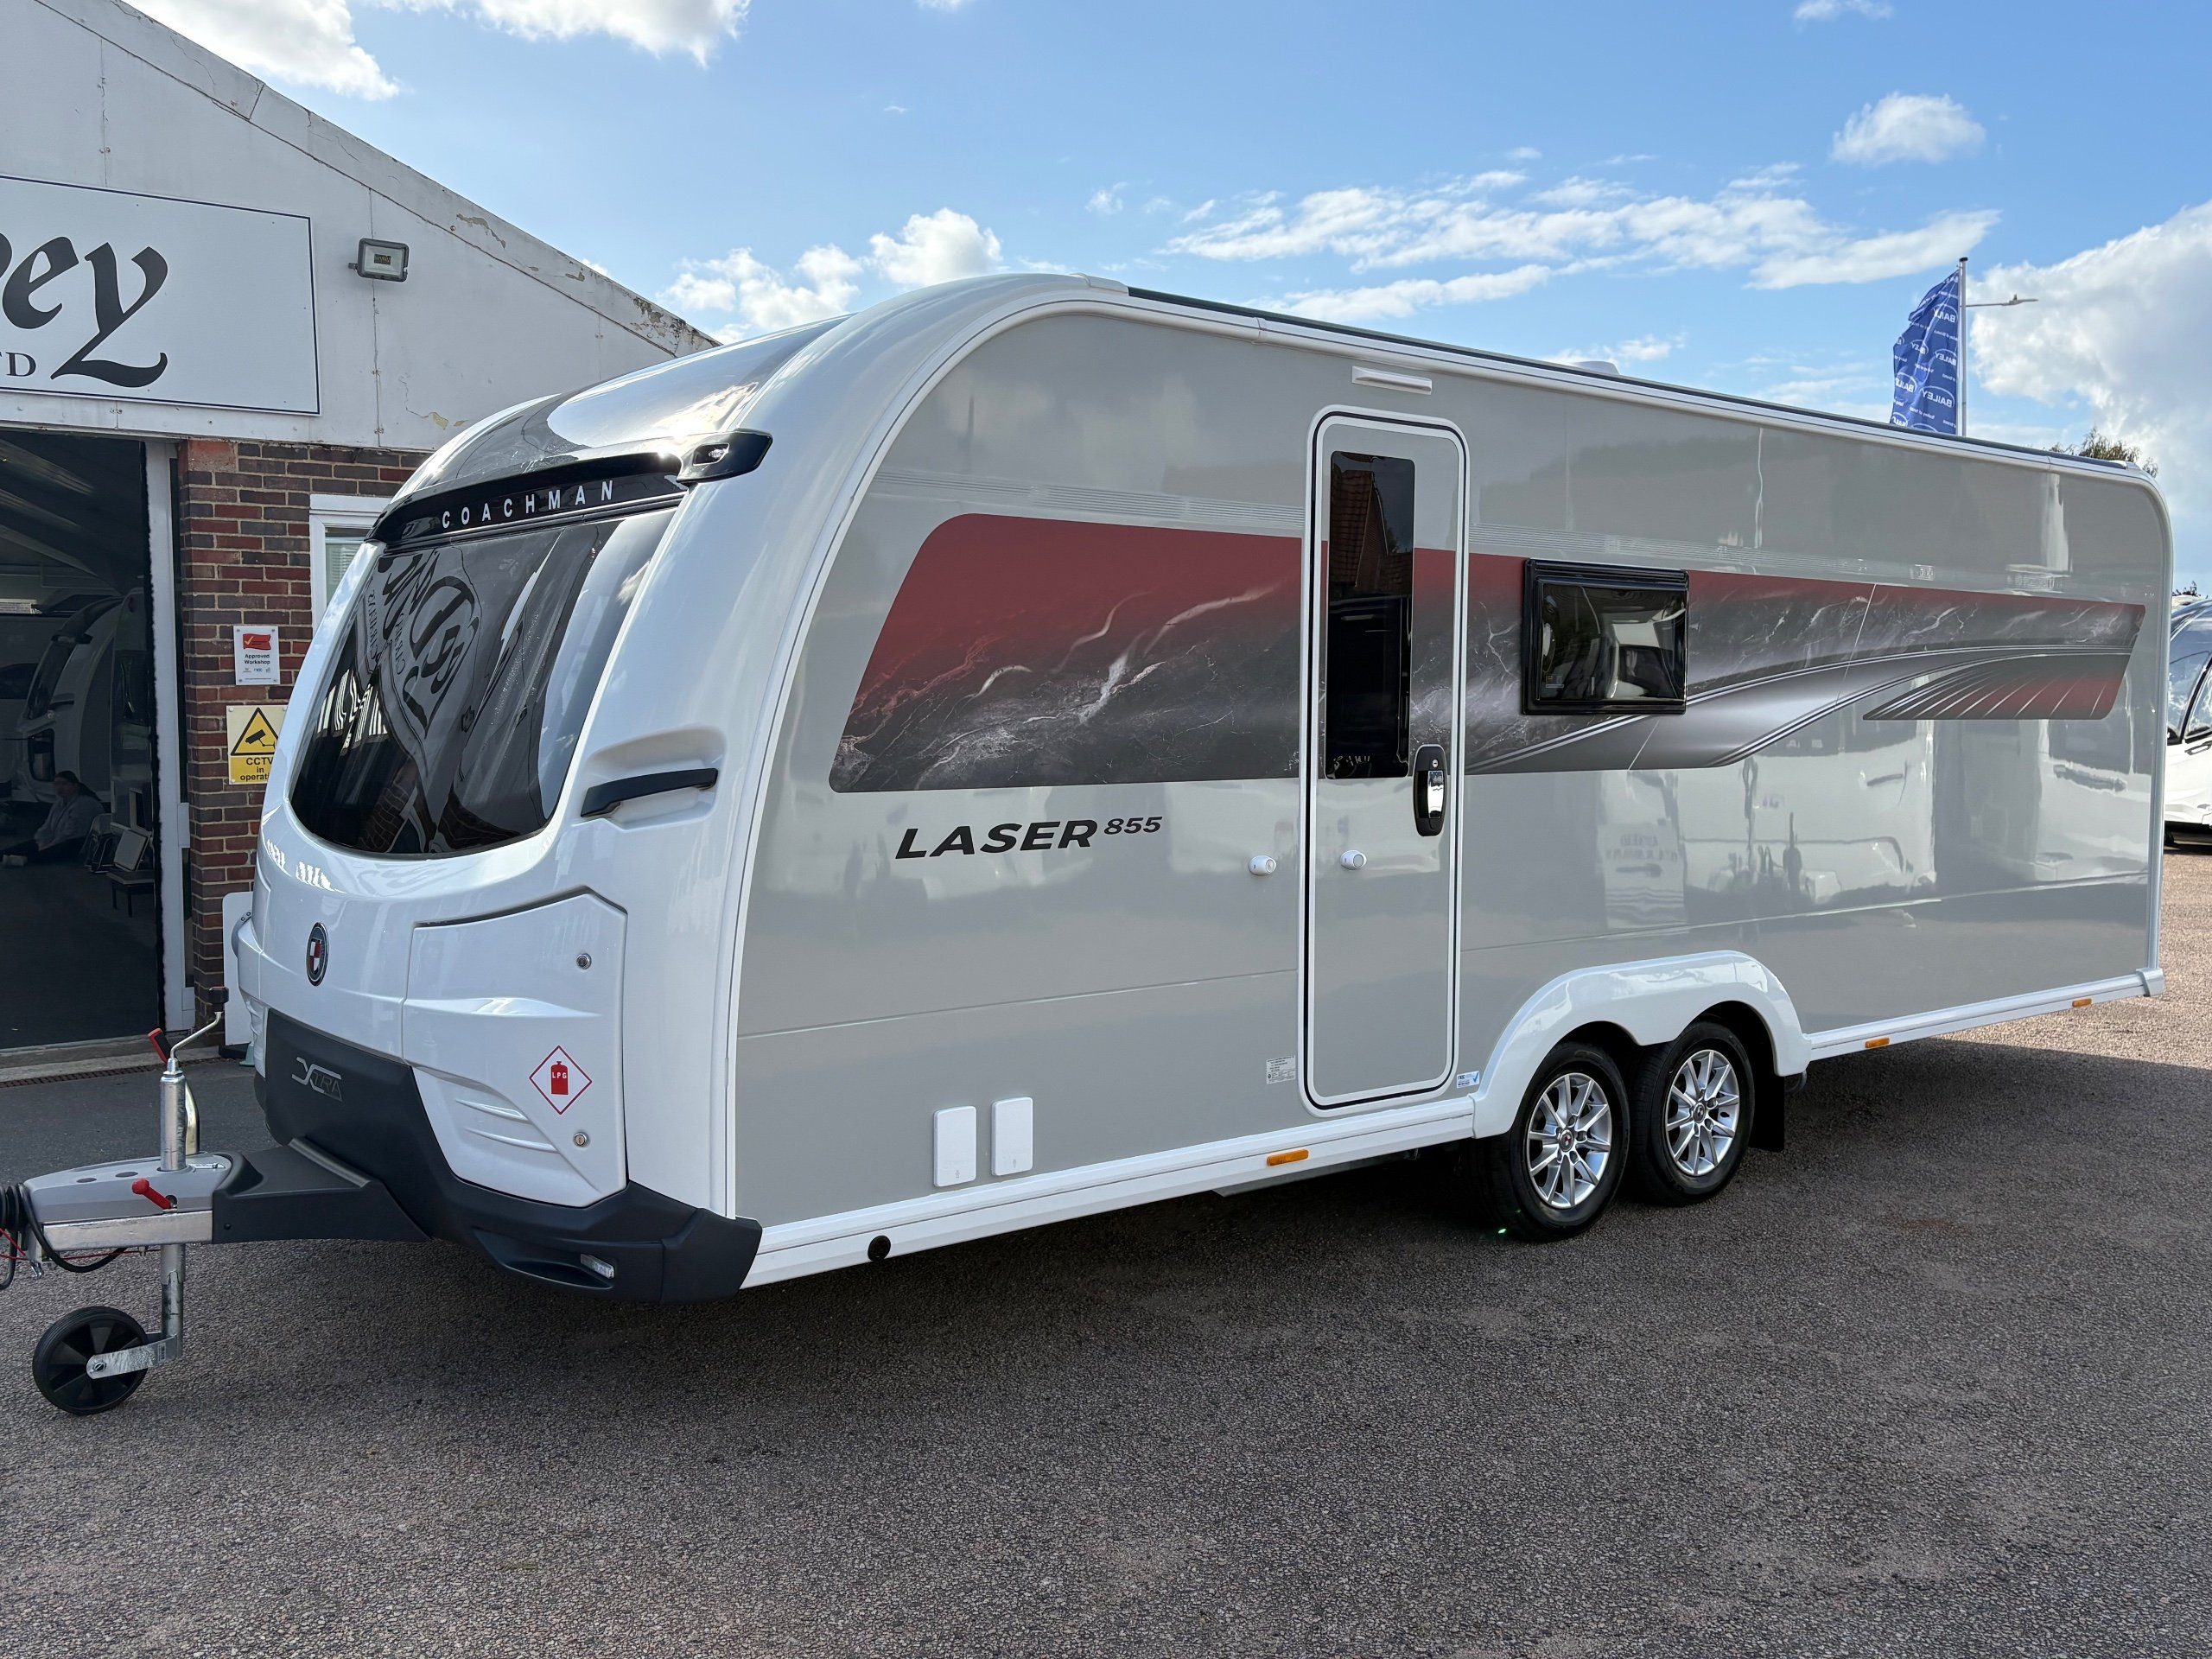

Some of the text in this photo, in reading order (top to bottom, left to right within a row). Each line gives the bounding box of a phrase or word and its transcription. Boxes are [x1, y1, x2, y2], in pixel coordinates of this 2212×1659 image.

[0, 233, 168, 388] ey
[0, 352, 36, 377] D
[442, 480, 613, 528] COACHMAN
[245, 757, 274, 766] CCTV
[895, 816, 1163, 859] LASER 855
